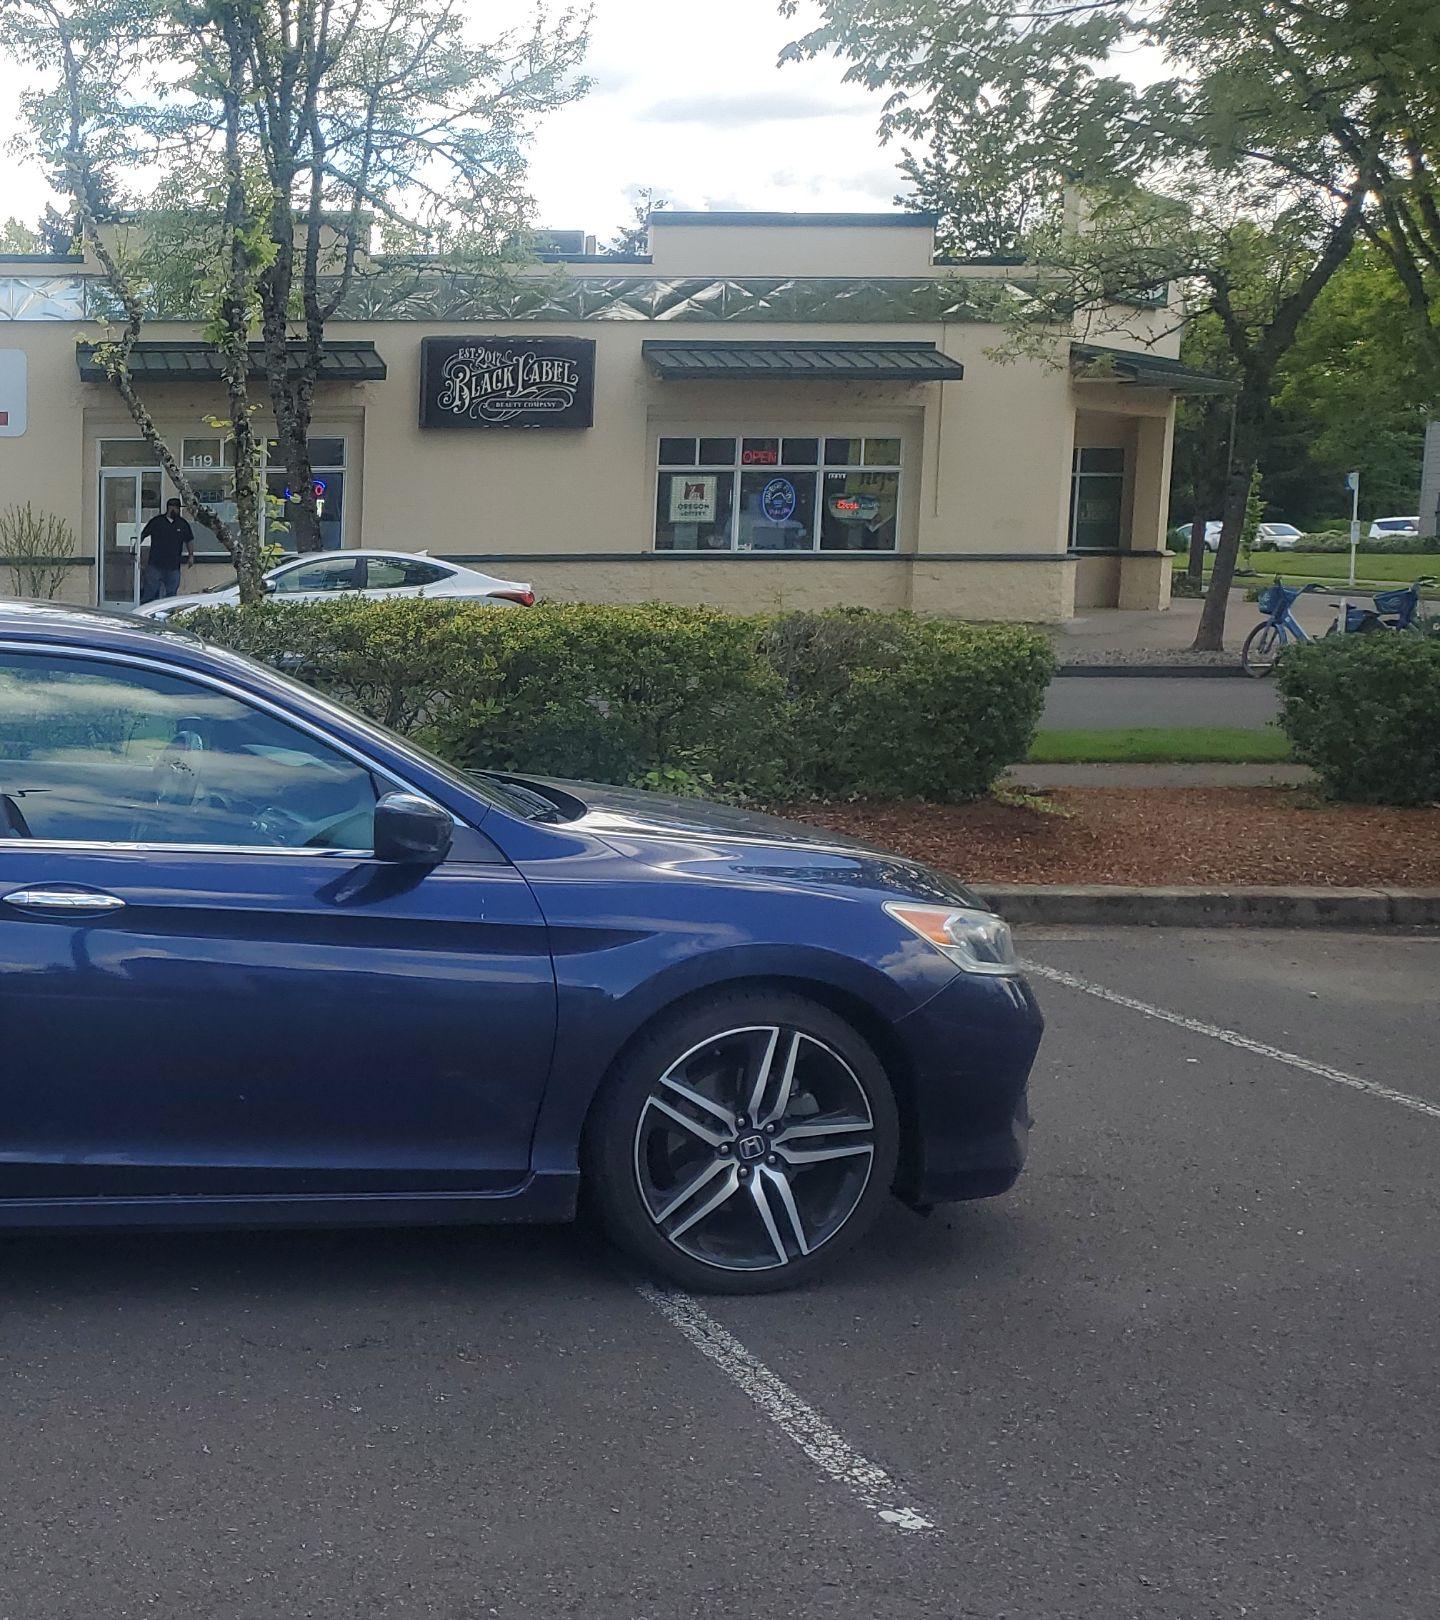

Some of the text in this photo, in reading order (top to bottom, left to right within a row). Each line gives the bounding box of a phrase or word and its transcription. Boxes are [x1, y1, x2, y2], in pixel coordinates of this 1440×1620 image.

[476, 347, 502, 368] 2017
[190, 455, 213, 467] 119
[742, 450, 777, 464] OPEN
